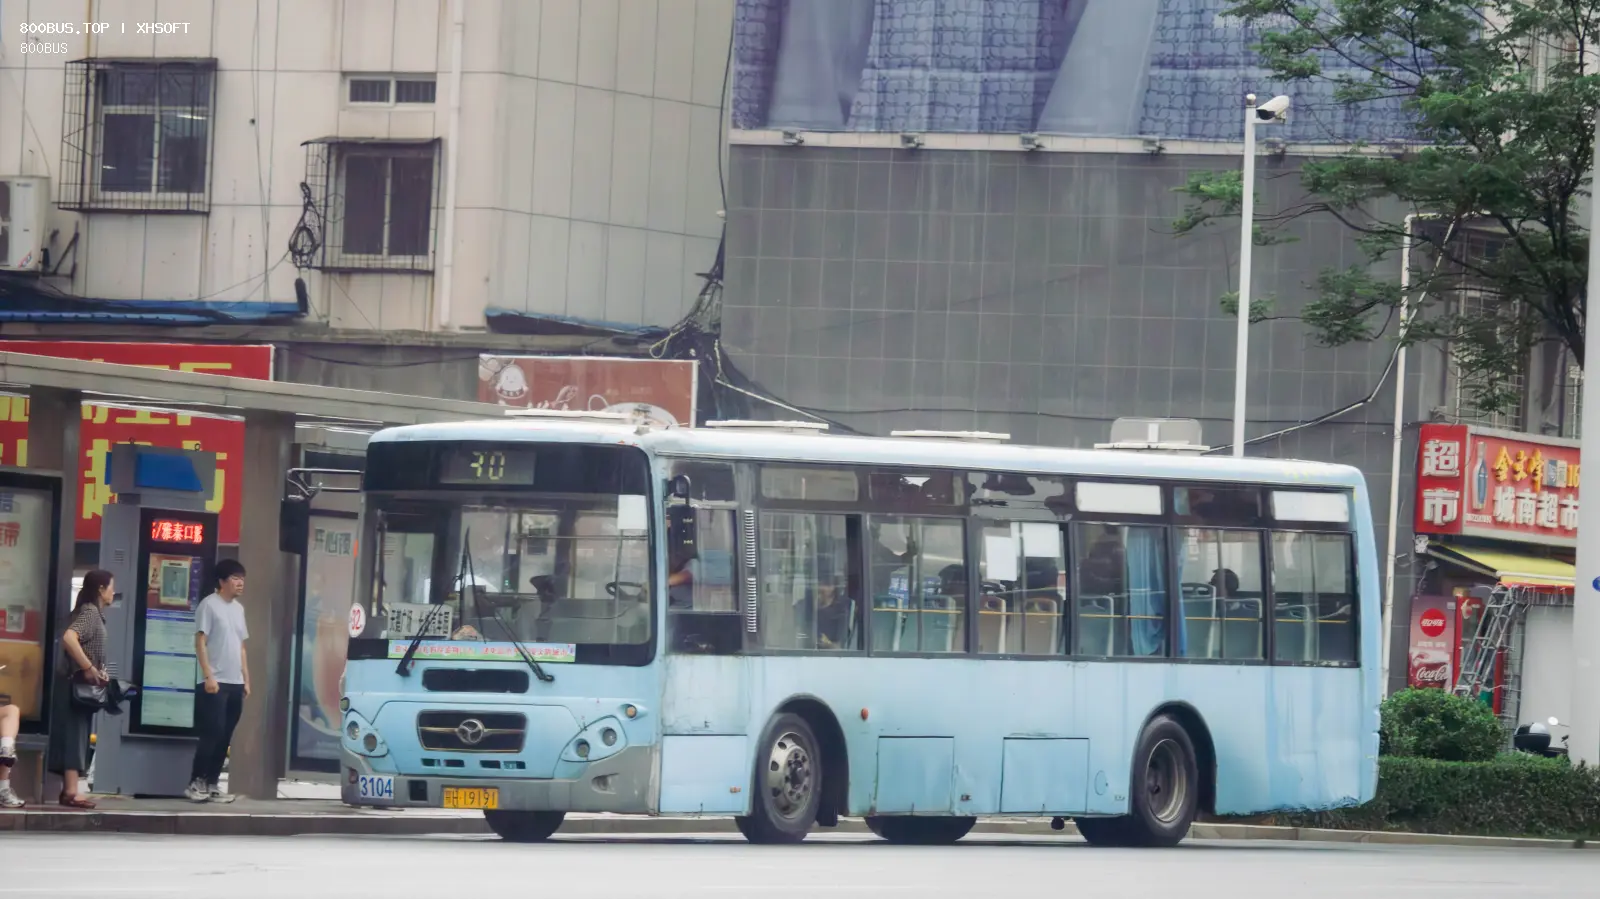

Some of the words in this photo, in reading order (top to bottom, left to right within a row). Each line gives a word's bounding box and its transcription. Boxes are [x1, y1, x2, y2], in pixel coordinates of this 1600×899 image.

[470, 451, 506, 480] 30
[1422, 439, 1460, 526] 超市
[1493, 486, 1580, 530] 城南超市
[360, 777, 393, 797] 3104
